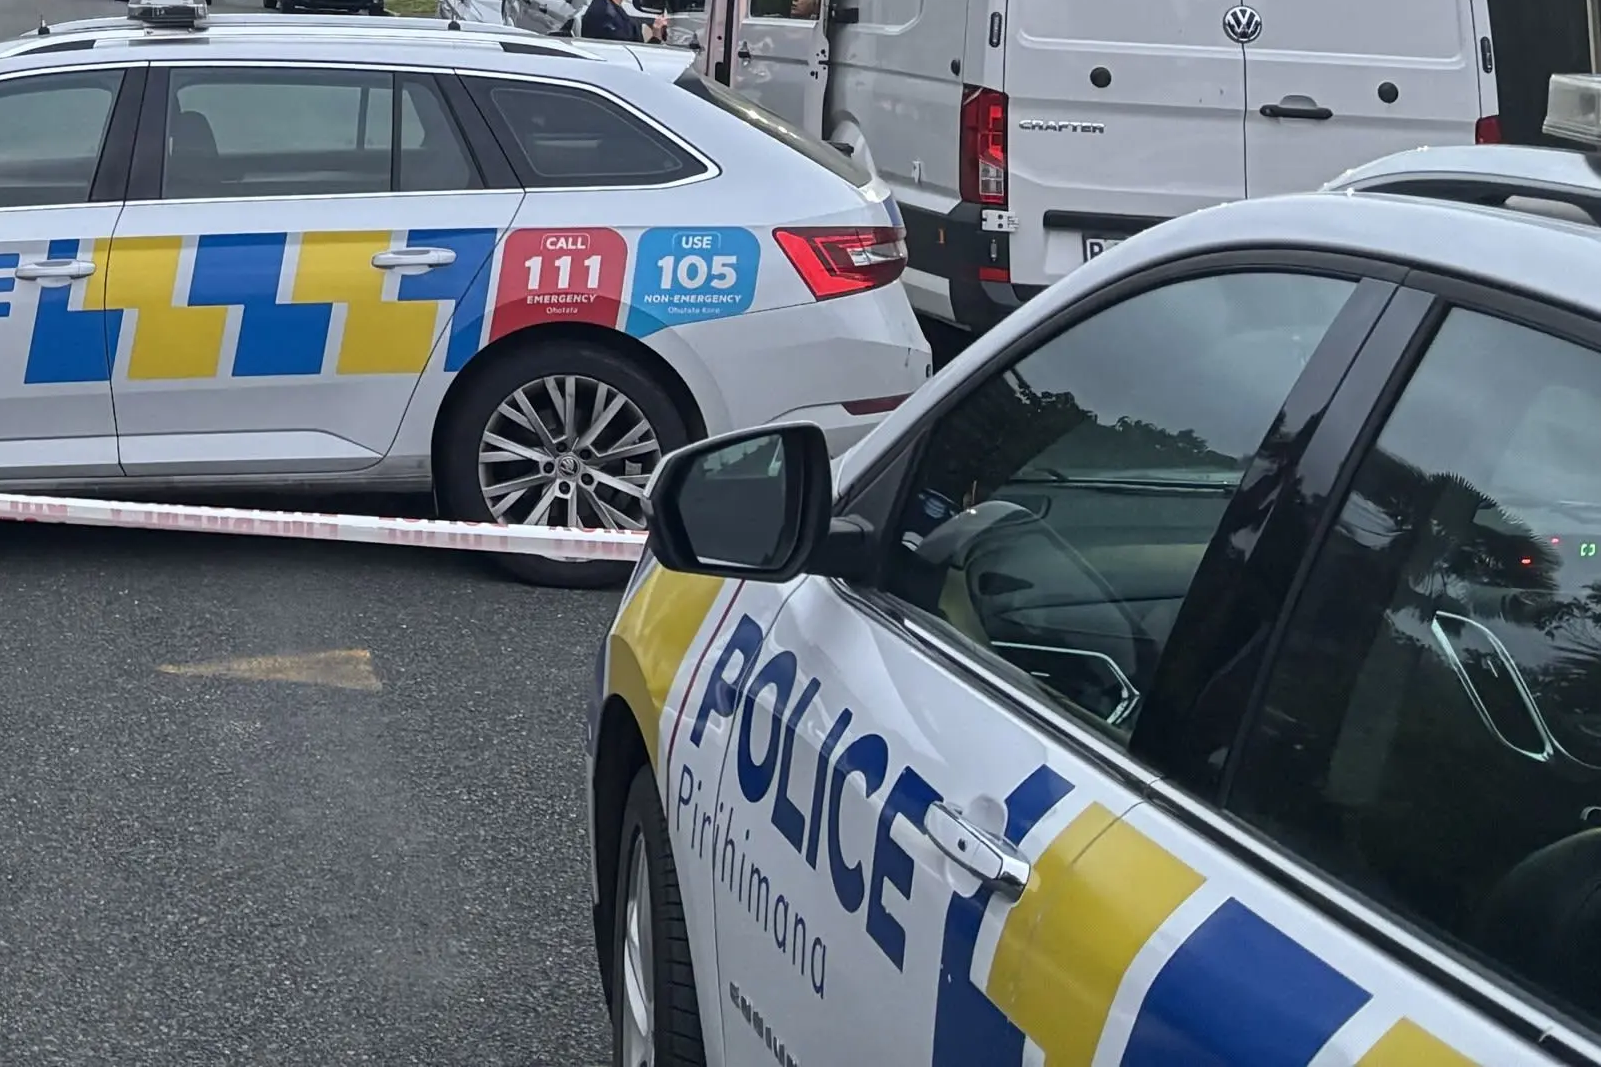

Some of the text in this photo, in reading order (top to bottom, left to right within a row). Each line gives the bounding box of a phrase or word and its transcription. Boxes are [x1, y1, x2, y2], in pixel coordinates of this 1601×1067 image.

[1019, 119, 1105, 134] CRAFTER
[545, 236, 587, 250] CALL
[681, 235, 713, 250] USE
[524, 254, 602, 290] 111
[657, 254, 737, 290] 105
[526, 294, 598, 305] EMERGENCY
[644, 293, 742, 304] NON-EMERGENCY
[690, 613, 944, 973] POLICE
[676, 763, 827, 1000] Pirihimana
